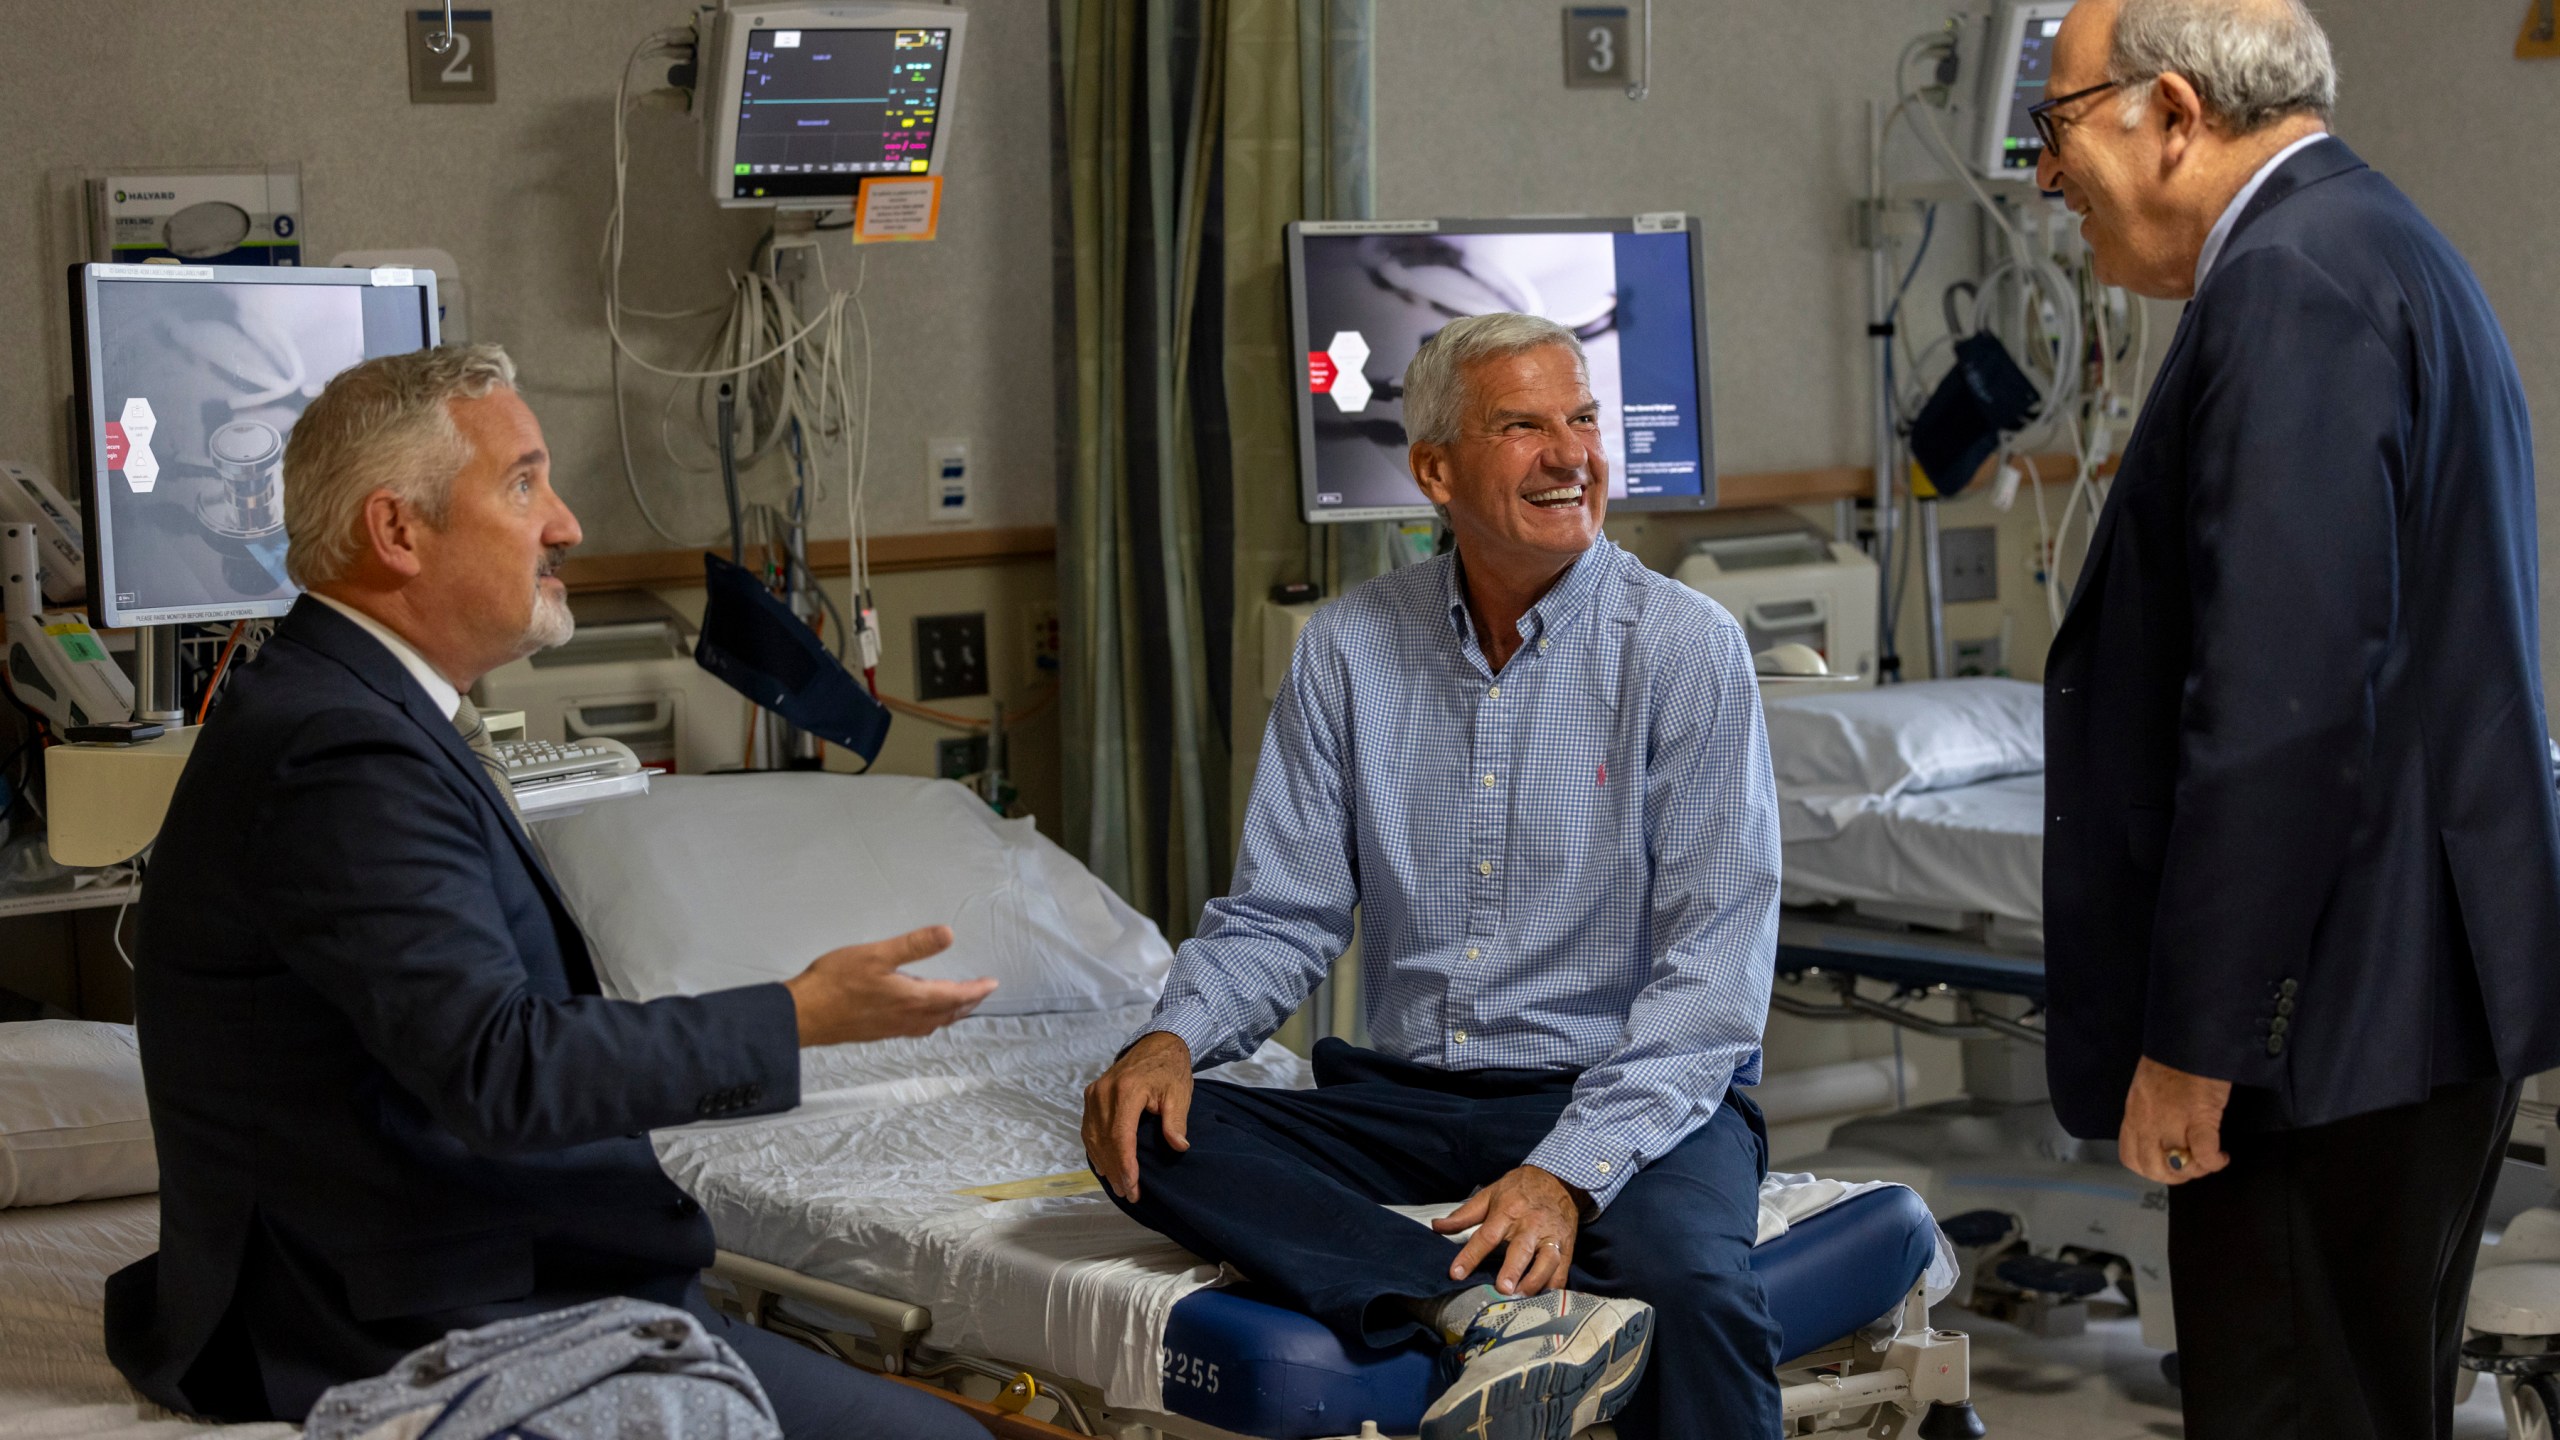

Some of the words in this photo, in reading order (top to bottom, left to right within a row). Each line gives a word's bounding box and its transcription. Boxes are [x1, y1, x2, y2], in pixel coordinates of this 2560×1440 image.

[441, 31, 473, 82] 2
[1588, 26, 1614, 73] 3
[128, 191, 176, 201] HALYARD
[279, 219, 289, 234] S
[1163, 1347, 1219, 1394] 2255
